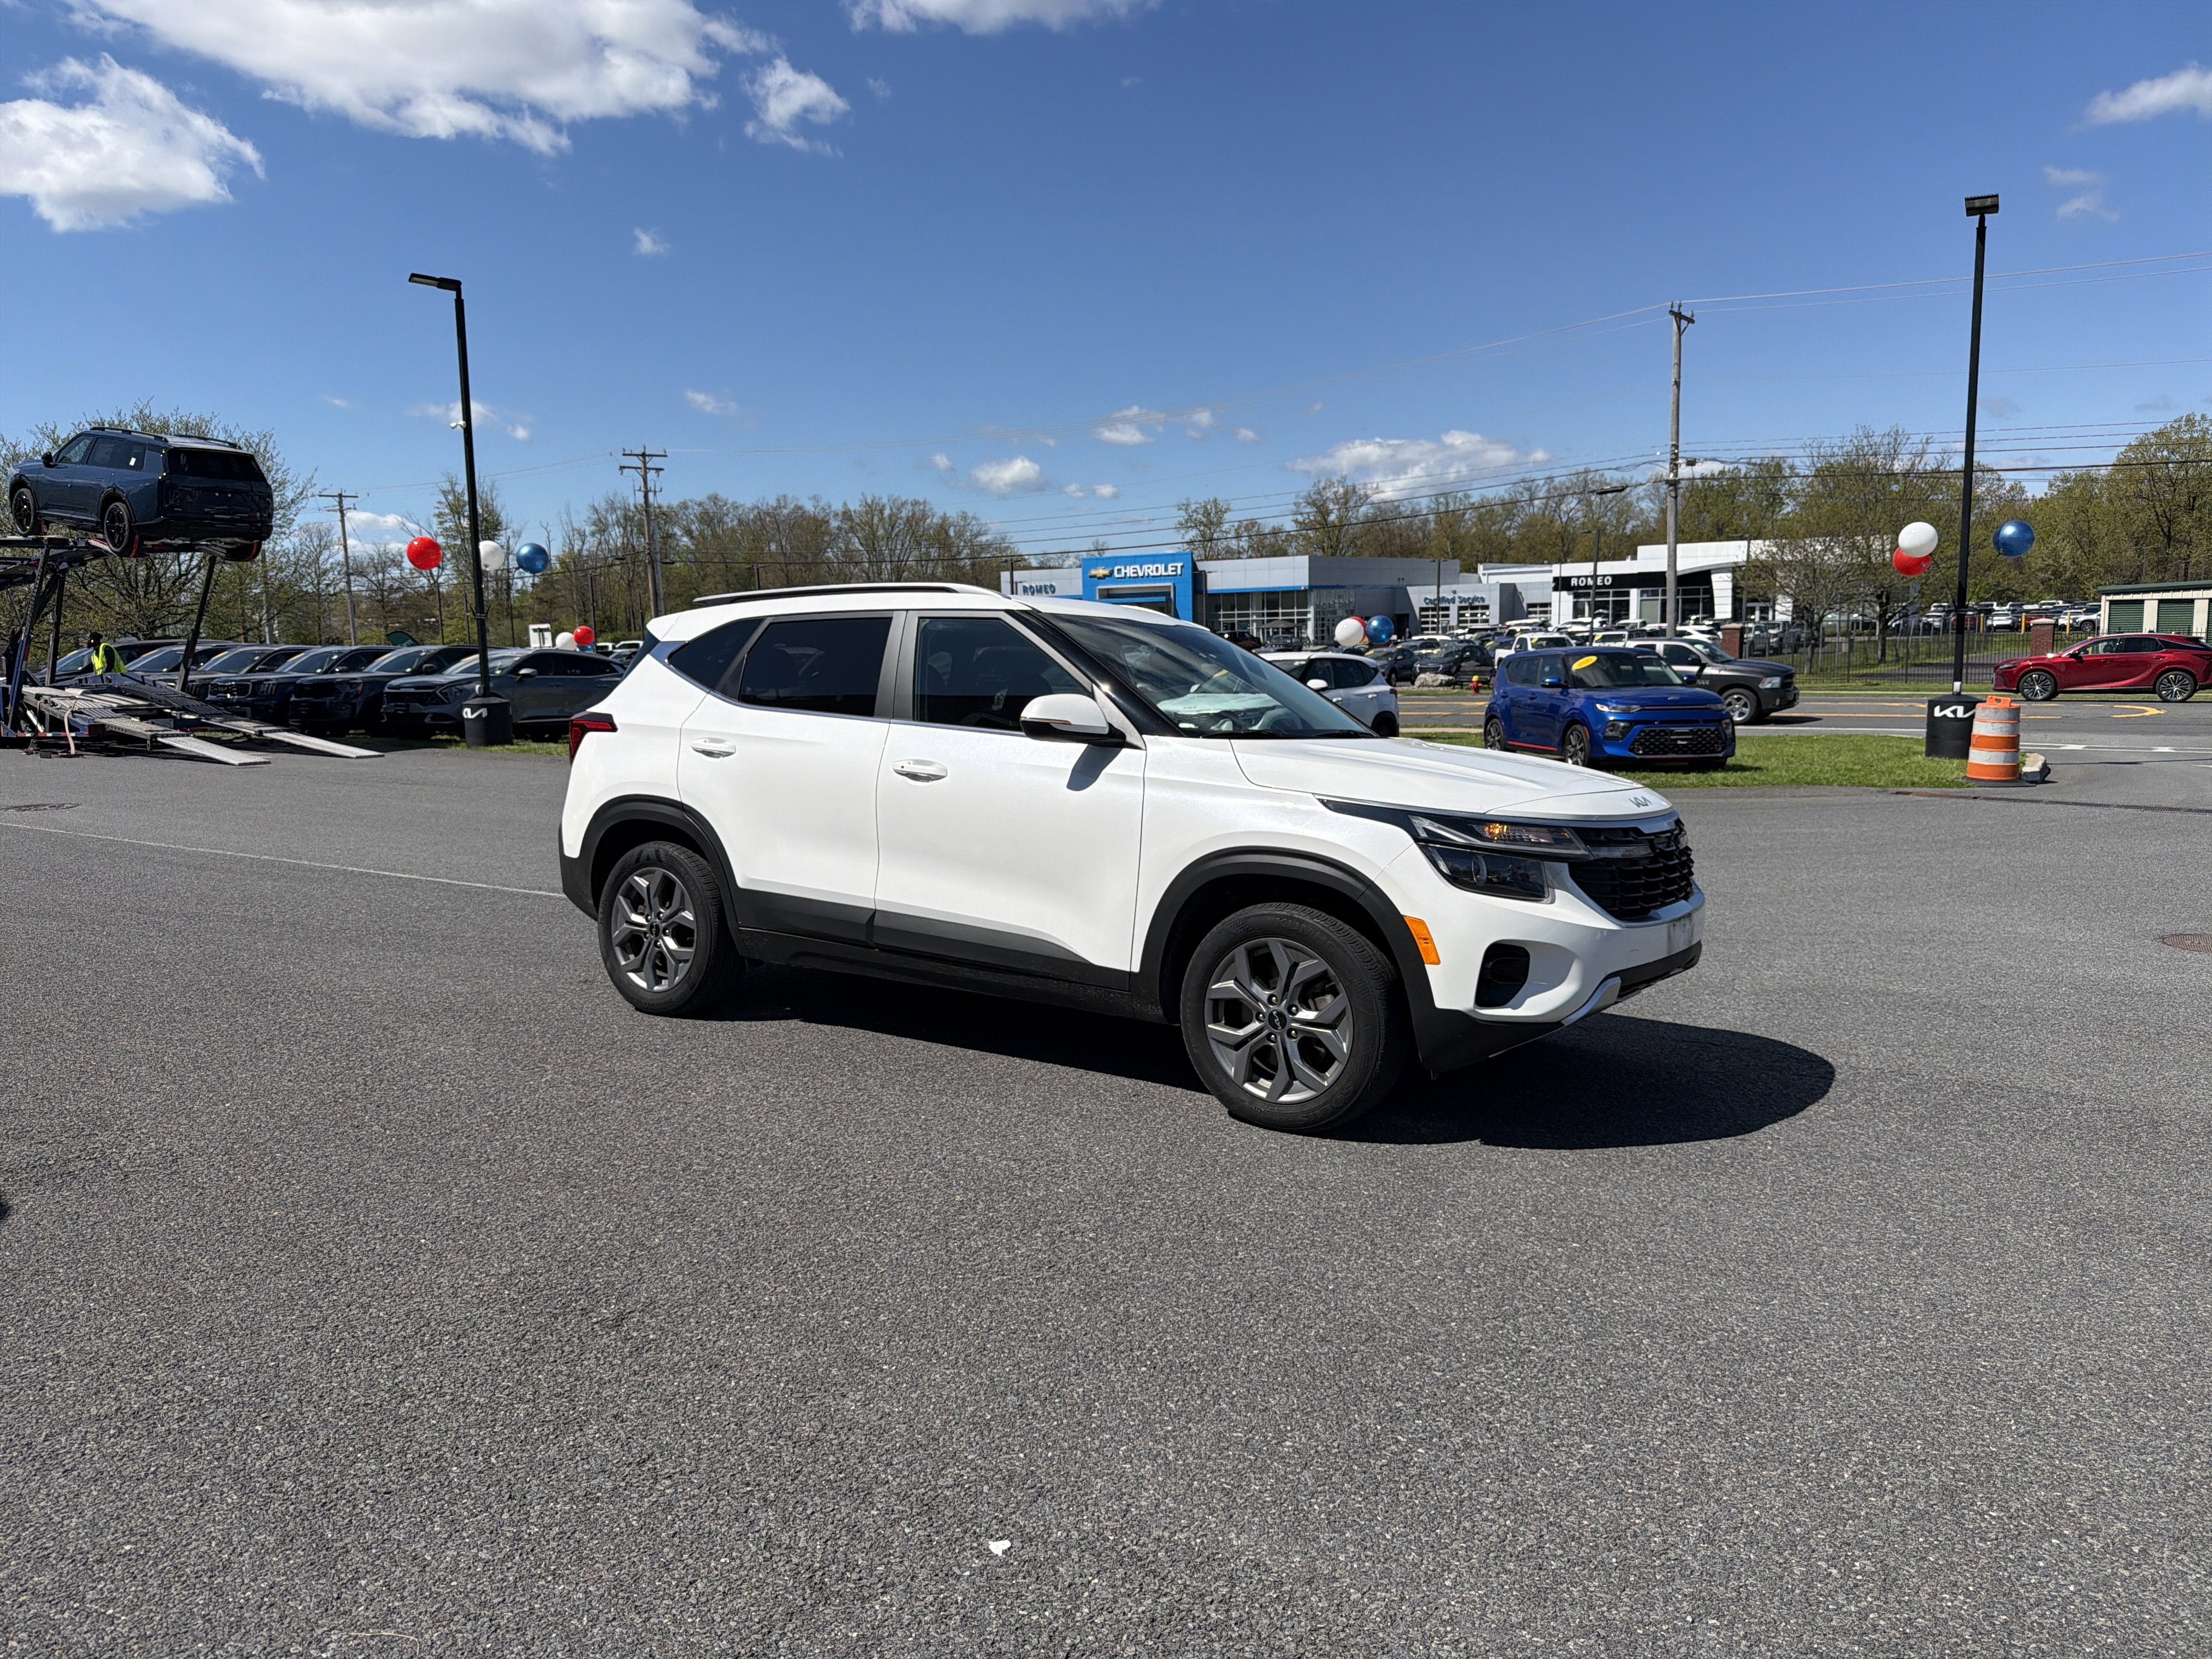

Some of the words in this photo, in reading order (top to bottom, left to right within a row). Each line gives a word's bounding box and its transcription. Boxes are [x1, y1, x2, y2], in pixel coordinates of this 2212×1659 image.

[1114, 562, 1183, 578] CHEVROLET
[1571, 575, 1612, 586] ROMEO
[1023, 584, 1056, 596] ROMEO
[1628, 795, 1652, 808] KIA
